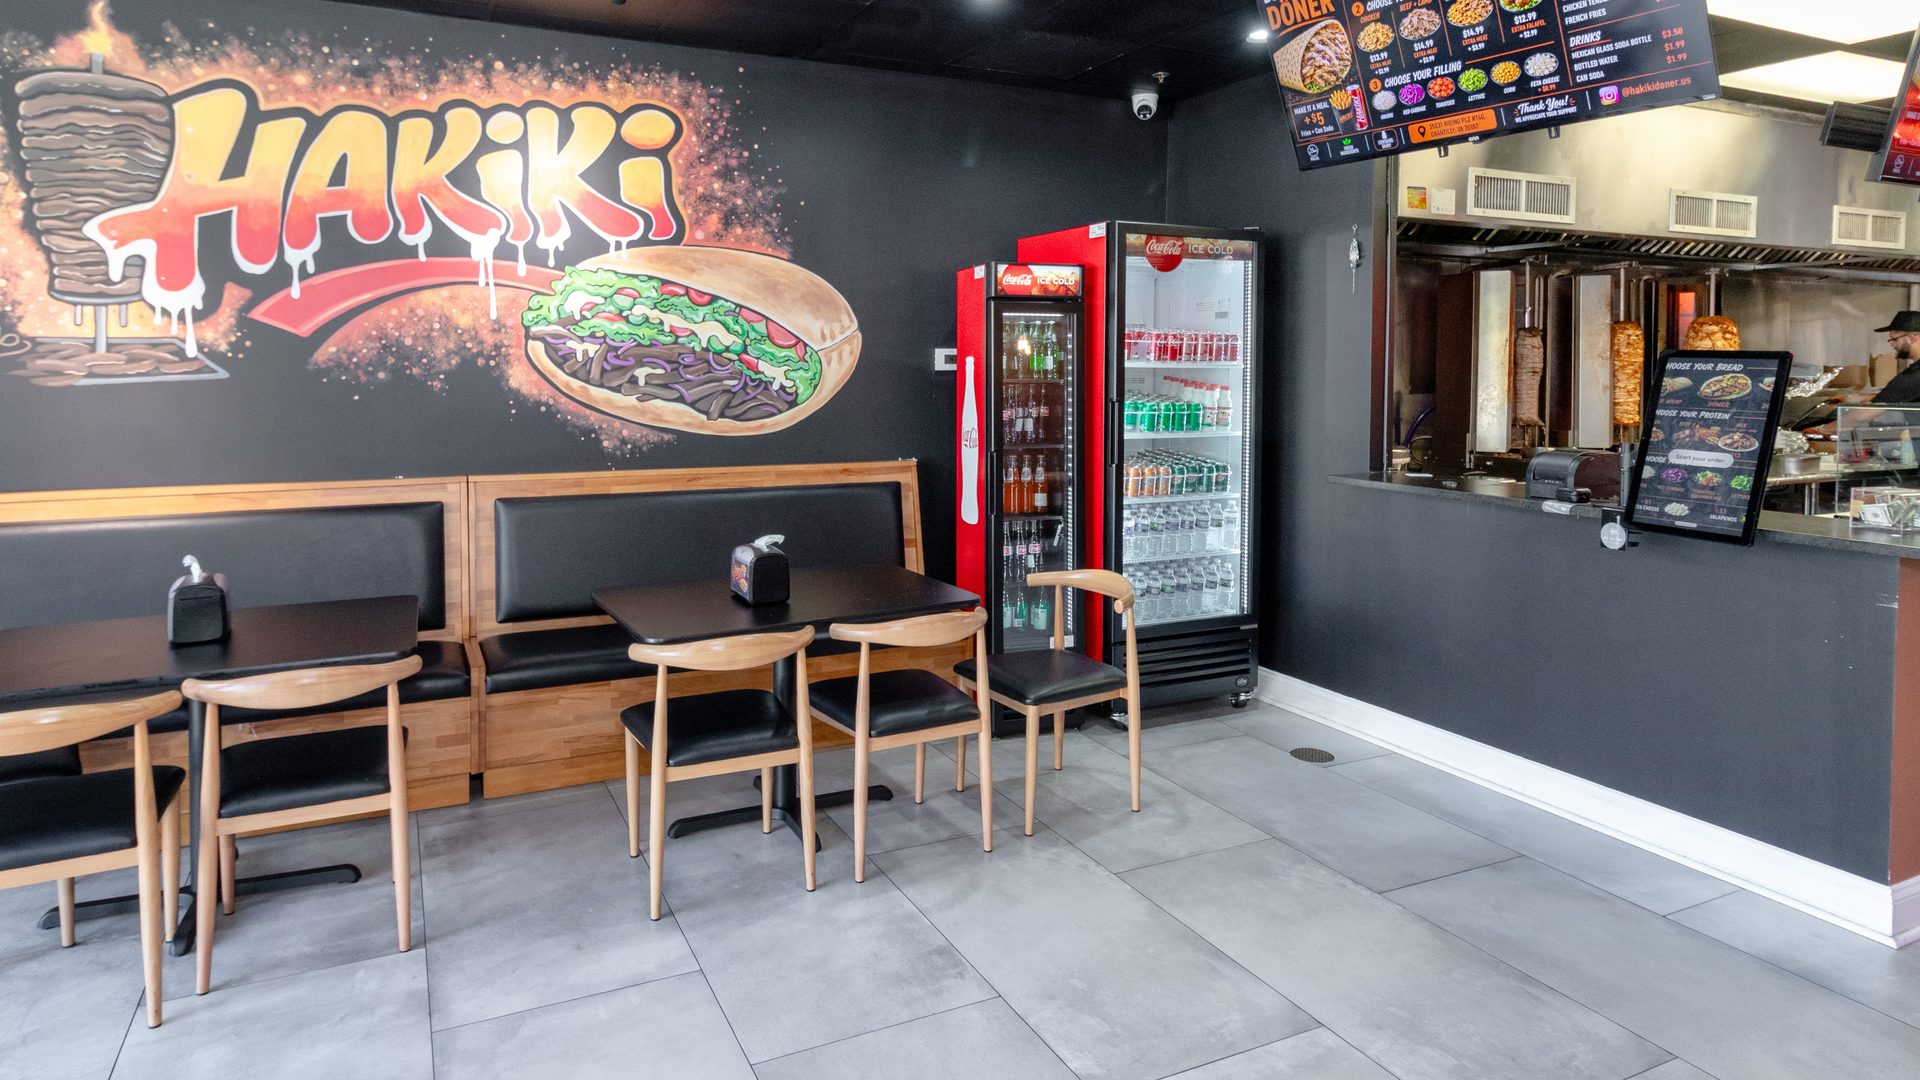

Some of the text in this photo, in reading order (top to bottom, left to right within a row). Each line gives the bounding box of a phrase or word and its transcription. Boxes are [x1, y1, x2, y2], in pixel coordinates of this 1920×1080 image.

[1563, 0, 1588, 13] CHICKEN
[1514, 11, 1537, 25] $12.99
[1565, 8, 1607, 25] FRENCH FRIES
[1462, 26, 1484, 39] $14.99
[1511, 24, 1526, 33] EXTRA
[1661, 27, 1684, 39] $3.50
[1569, 30, 1602, 47] DRINKS
[1414, 39, 1434, 51] $14.99
[1571, 34, 1652, 60] MEXICAN GLASS SODA BOTTLE
[1664, 40, 1685, 52] $1.99
[1370, 51, 1388, 63] $13.99
[1574, 55, 1619, 71] BOTTLED WATER
[1666, 52, 1687, 64] $1.99
[1384, 61, 1462, 88] CHOOSE YOUR FILLING
[1576, 70, 1605, 83] CAN SODA
[1530, 76, 1560, 88] FETA CHEESE
[1621, 76, 1692, 98] @hakikidoner.us
[1503, 86, 1516, 94] CORN
[1467, 93, 1485, 102] LETTUCE
[1293, 106, 1307, 115] MAKE
[1318, 101, 1330, 110] MEAL
[1517, 94, 1569, 115] Thank You!
[1558, 106, 1577, 116] SUPPORT
[1300, 129, 1311, 137] Fries
[1315, 127, 1324, 135] Can
[1188, 244, 1233, 255] ICE COLD
[1053, 277, 1075, 285] COLD
[1665, 362, 1744, 371] HOOSE YOUR BREAD
[1655, 408, 1731, 420] HOOSE YOUR PROTEIN
[1645, 455, 1667, 463] HOOSE
[1692, 455, 1707, 463] your
